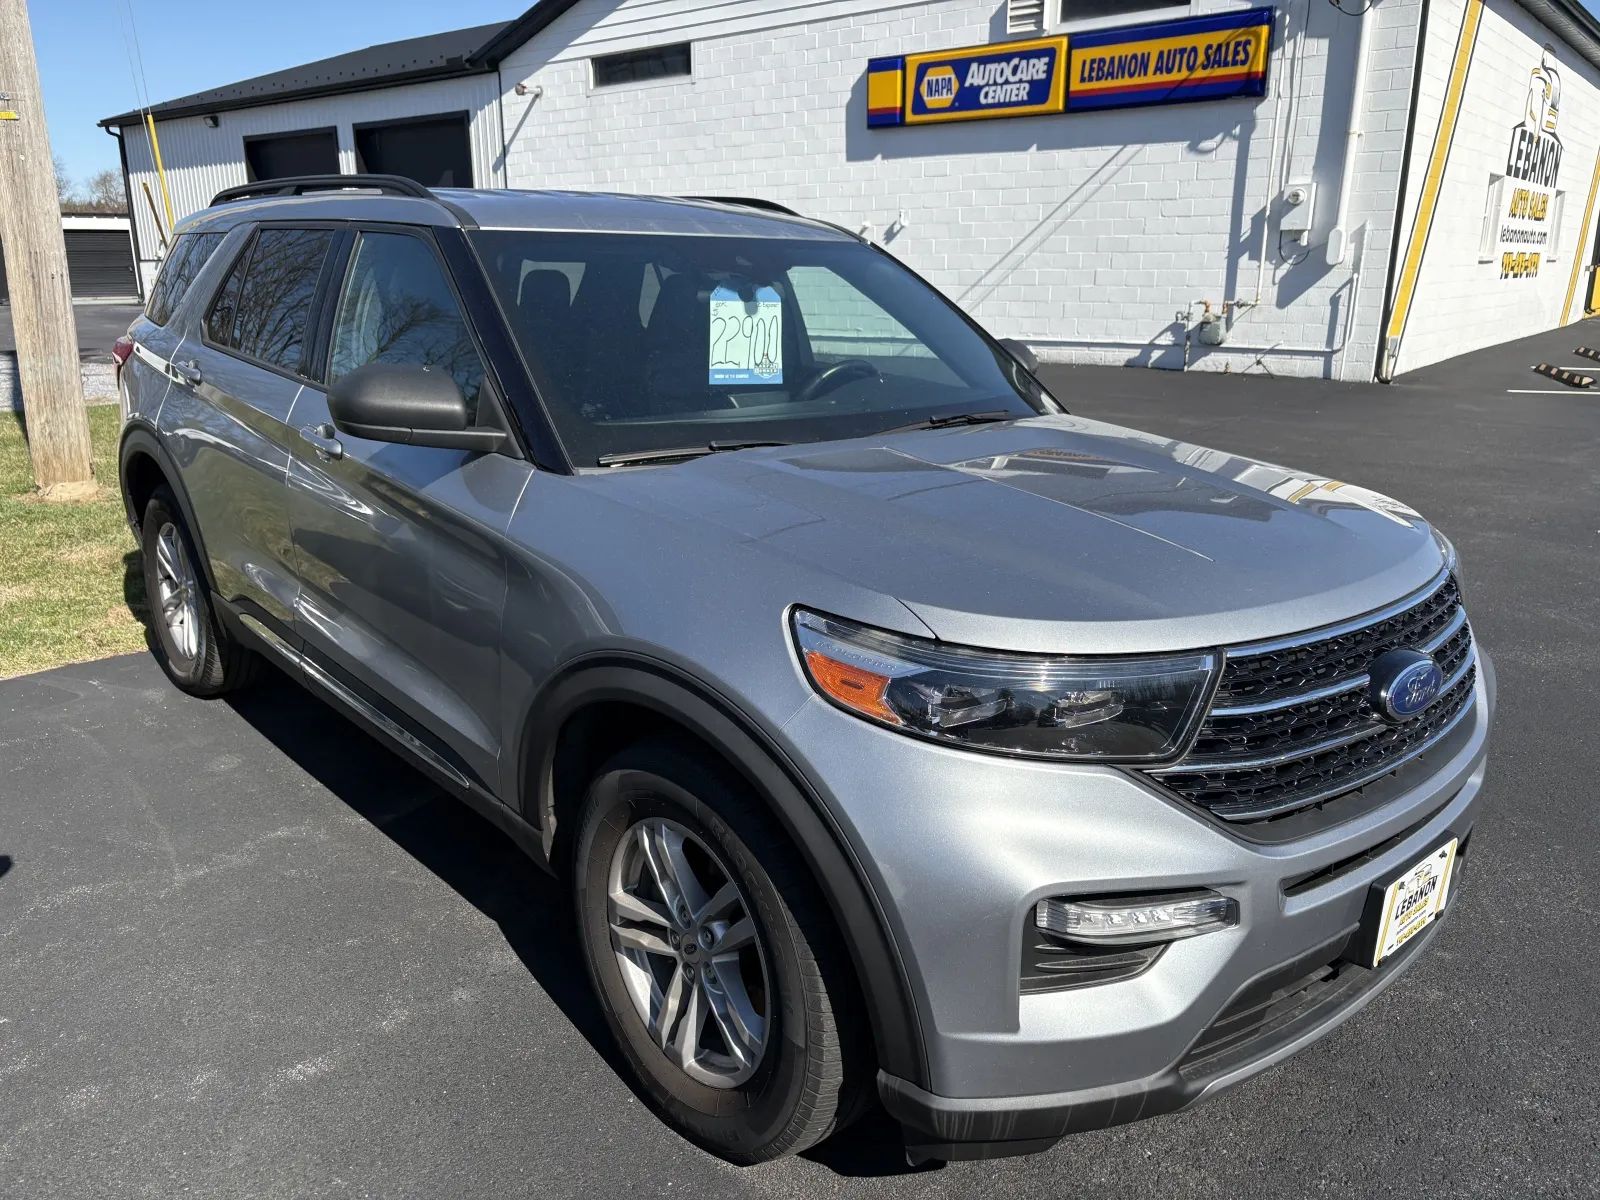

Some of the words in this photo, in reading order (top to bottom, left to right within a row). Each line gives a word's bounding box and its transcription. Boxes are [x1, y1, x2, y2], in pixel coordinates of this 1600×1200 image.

[1079, 52, 1151, 84] LEBANON
[1153, 46, 1198, 76] AUTO
[1201, 39, 1252, 71] SALES
[926, 76, 953, 98] NAPA
[979, 83, 1030, 105] CENTER
[1506, 128, 1563, 189] LEBANON
[1508, 187, 1530, 220] AUTO
[711, 315, 779, 370] 22900
[1405, 668, 1437, 708] Ford
[1395, 876, 1438, 920] LEBANON
